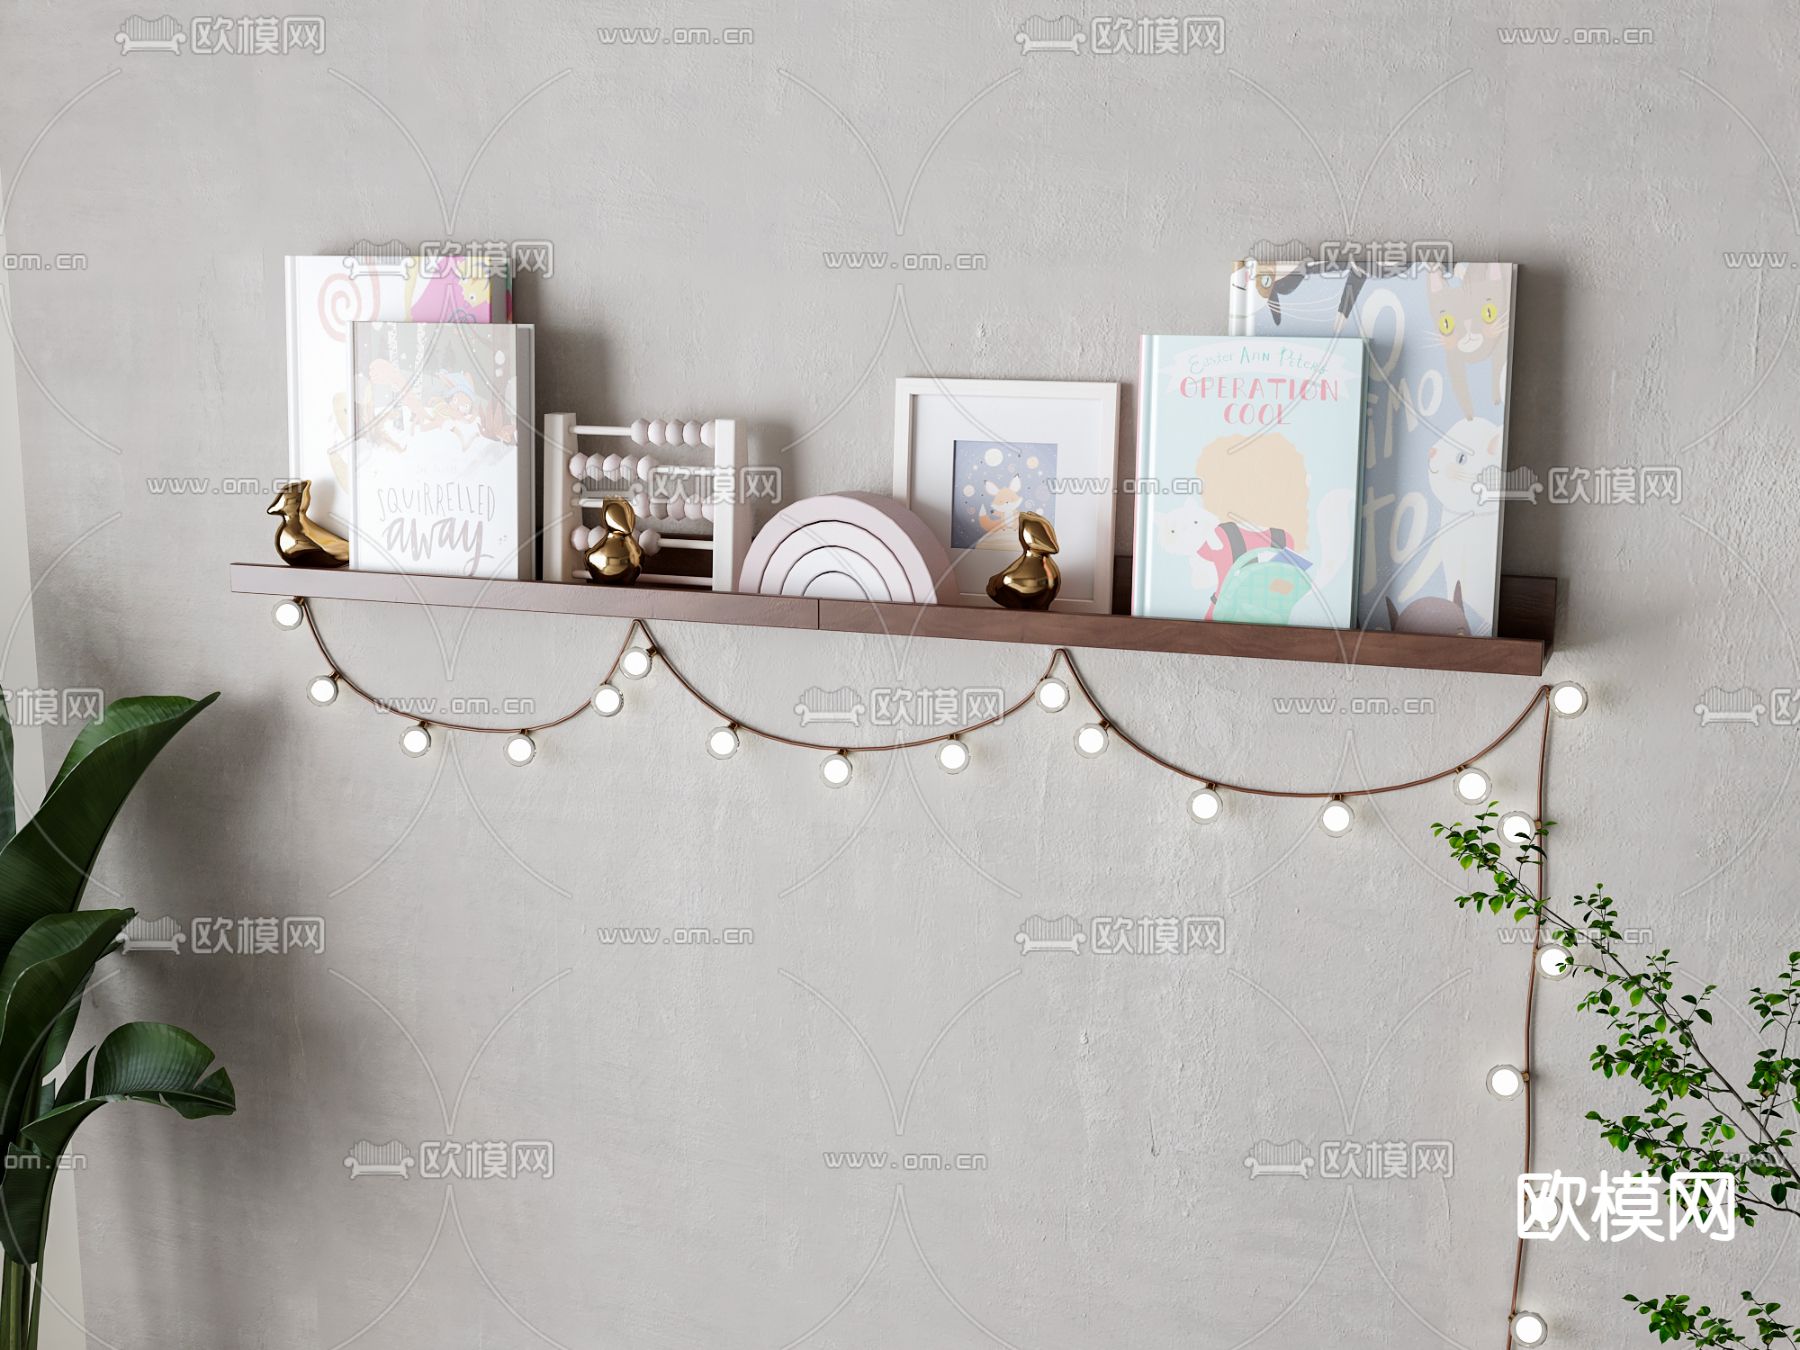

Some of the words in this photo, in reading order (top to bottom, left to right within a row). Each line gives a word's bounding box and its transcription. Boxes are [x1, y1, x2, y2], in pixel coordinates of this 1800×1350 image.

[1179, 375, 1339, 402] OPERATION
[1223, 403, 1291, 425] COOL
[377, 482, 496, 522] SQUIRRELLED
[382, 516, 495, 577] away
